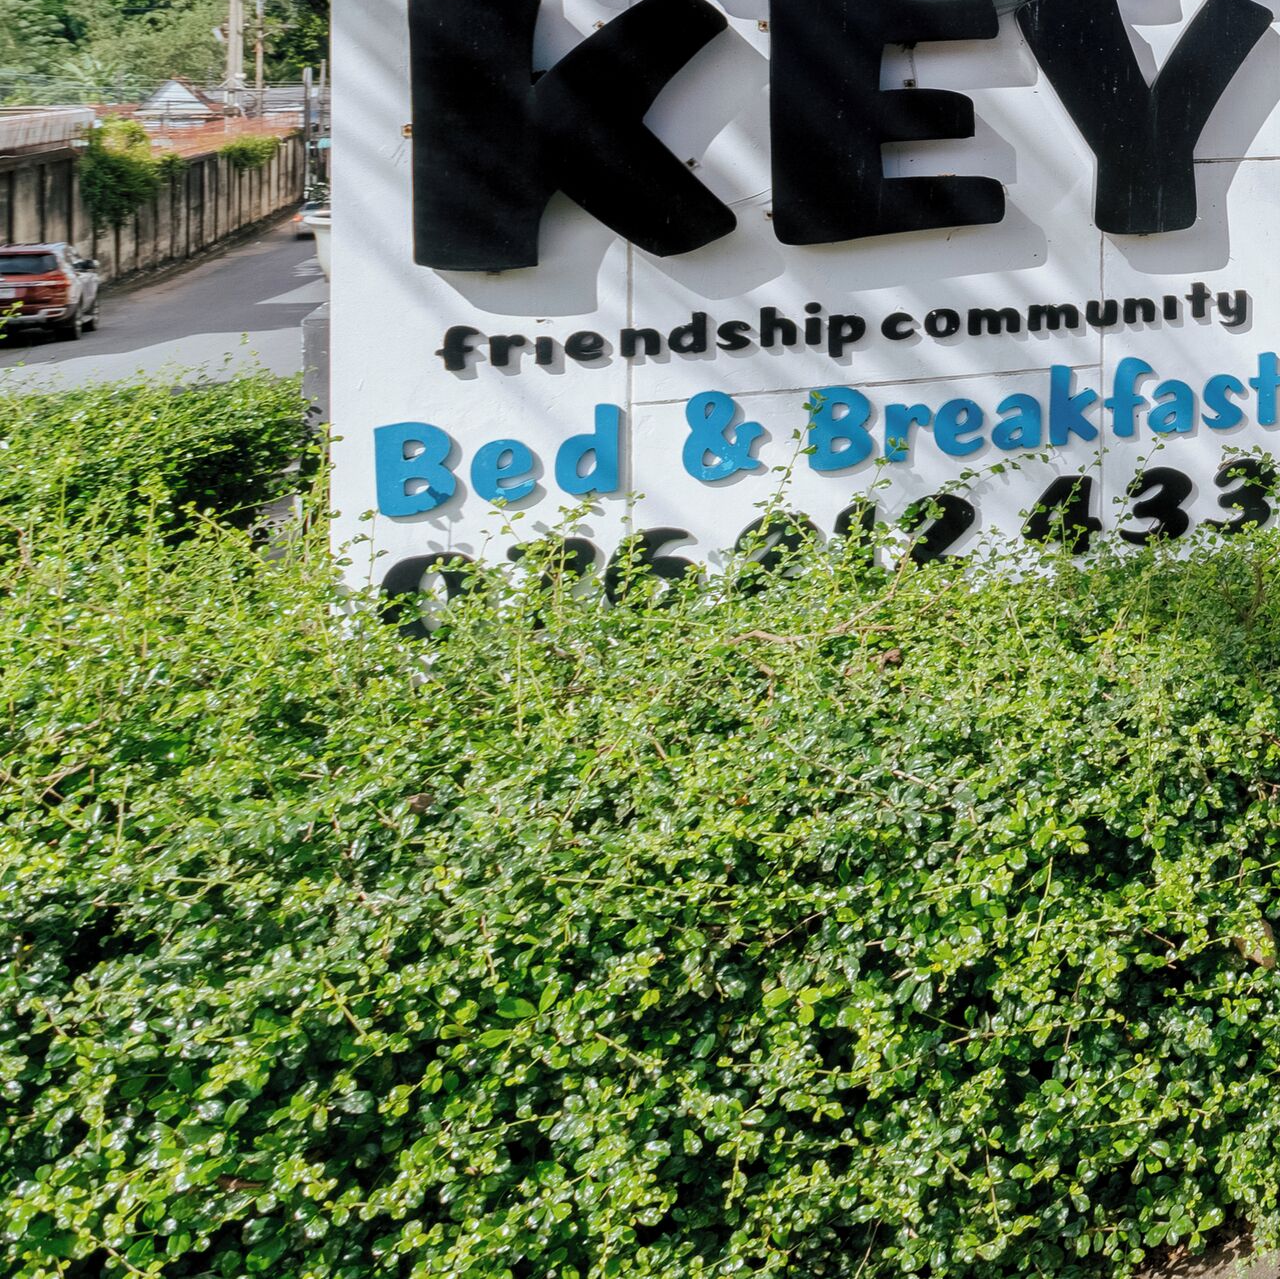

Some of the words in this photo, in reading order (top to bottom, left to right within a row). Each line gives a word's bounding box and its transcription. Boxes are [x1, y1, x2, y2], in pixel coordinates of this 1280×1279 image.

[440, 303, 868, 372] friendship
[881, 281, 1249, 342] community
[374, 403, 626, 517] Bed
[682, 390, 766, 483] &
[1020, 457, 1277, 556] 433
